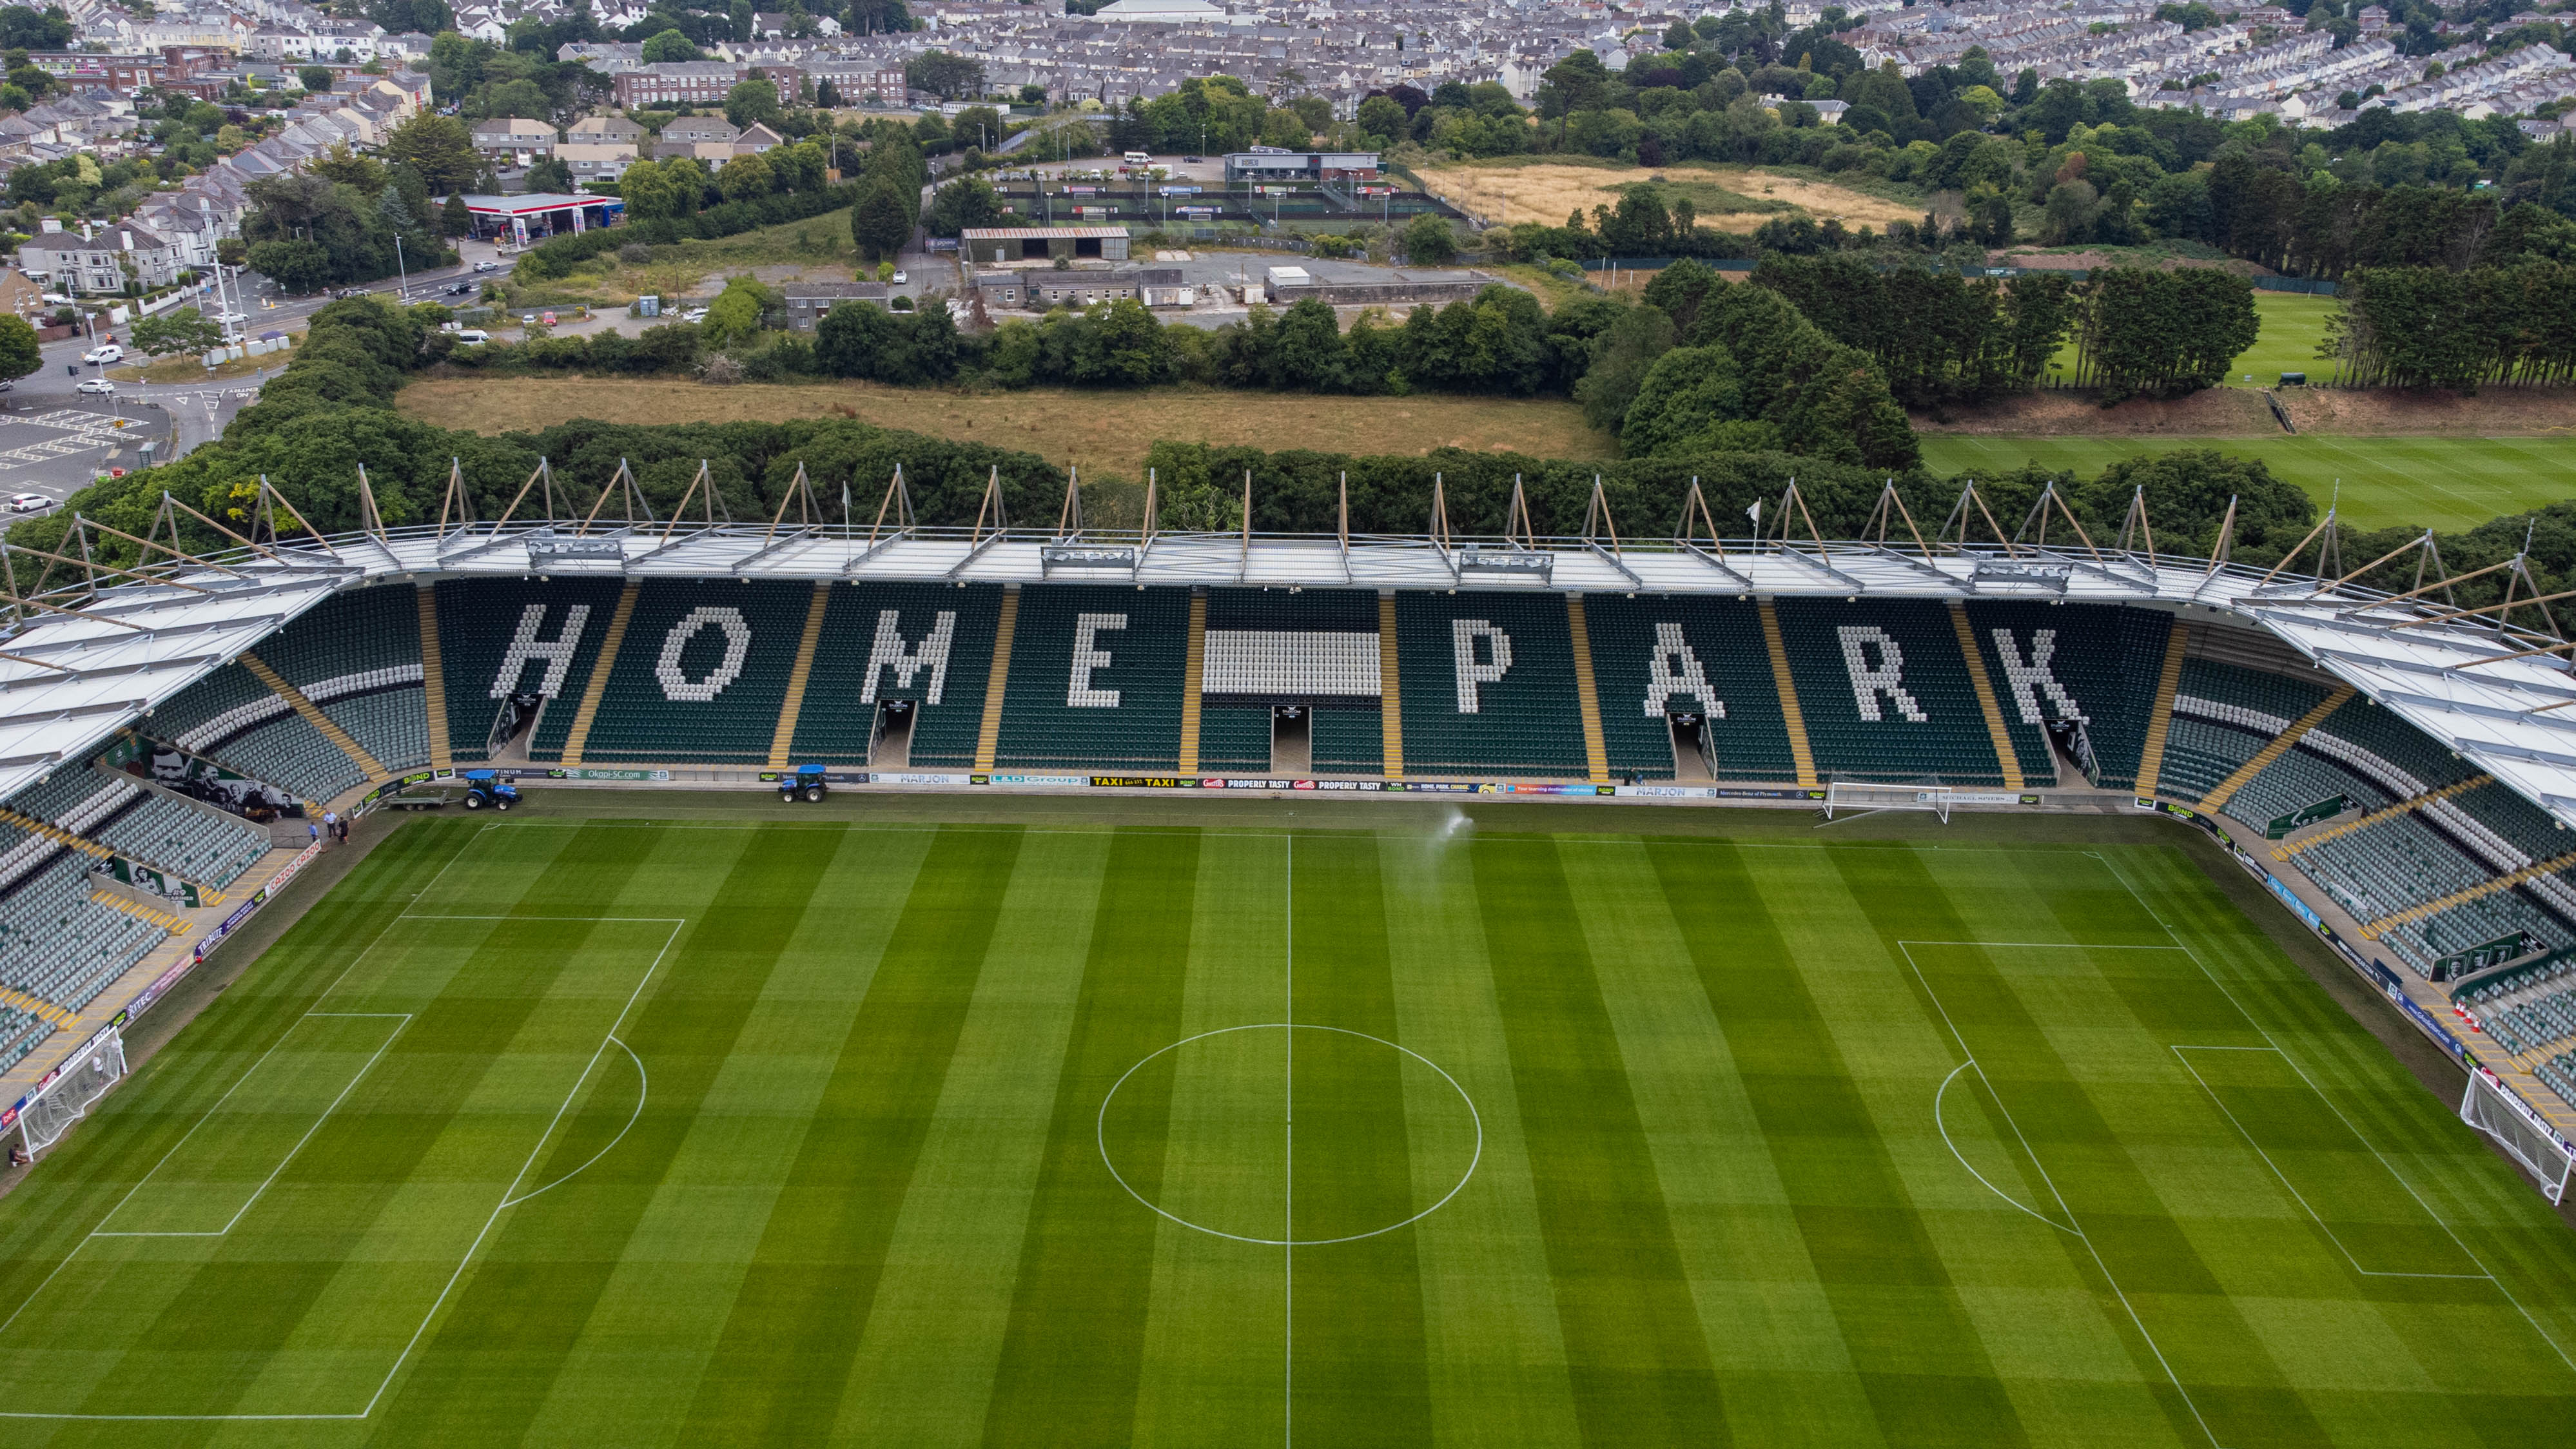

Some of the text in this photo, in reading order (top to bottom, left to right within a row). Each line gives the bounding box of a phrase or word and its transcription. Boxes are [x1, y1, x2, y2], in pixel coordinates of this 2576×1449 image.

[490, 604, 2089, 724] HOME PARK
[404, 773, 430, 784] BOND
[901, 775, 949, 783] MARJON
[1319, 781, 1357, 790] PROPERLY
[1360, 782, 1381, 790] TASTY
[1636, 788, 1685, 796] MARJON
[2167, 804, 2193, 818] BOND
[297, 842, 320, 866] CAZOO
[271, 864, 295, 890] CAZOO
[198, 928, 222, 954] TRIBUTE
